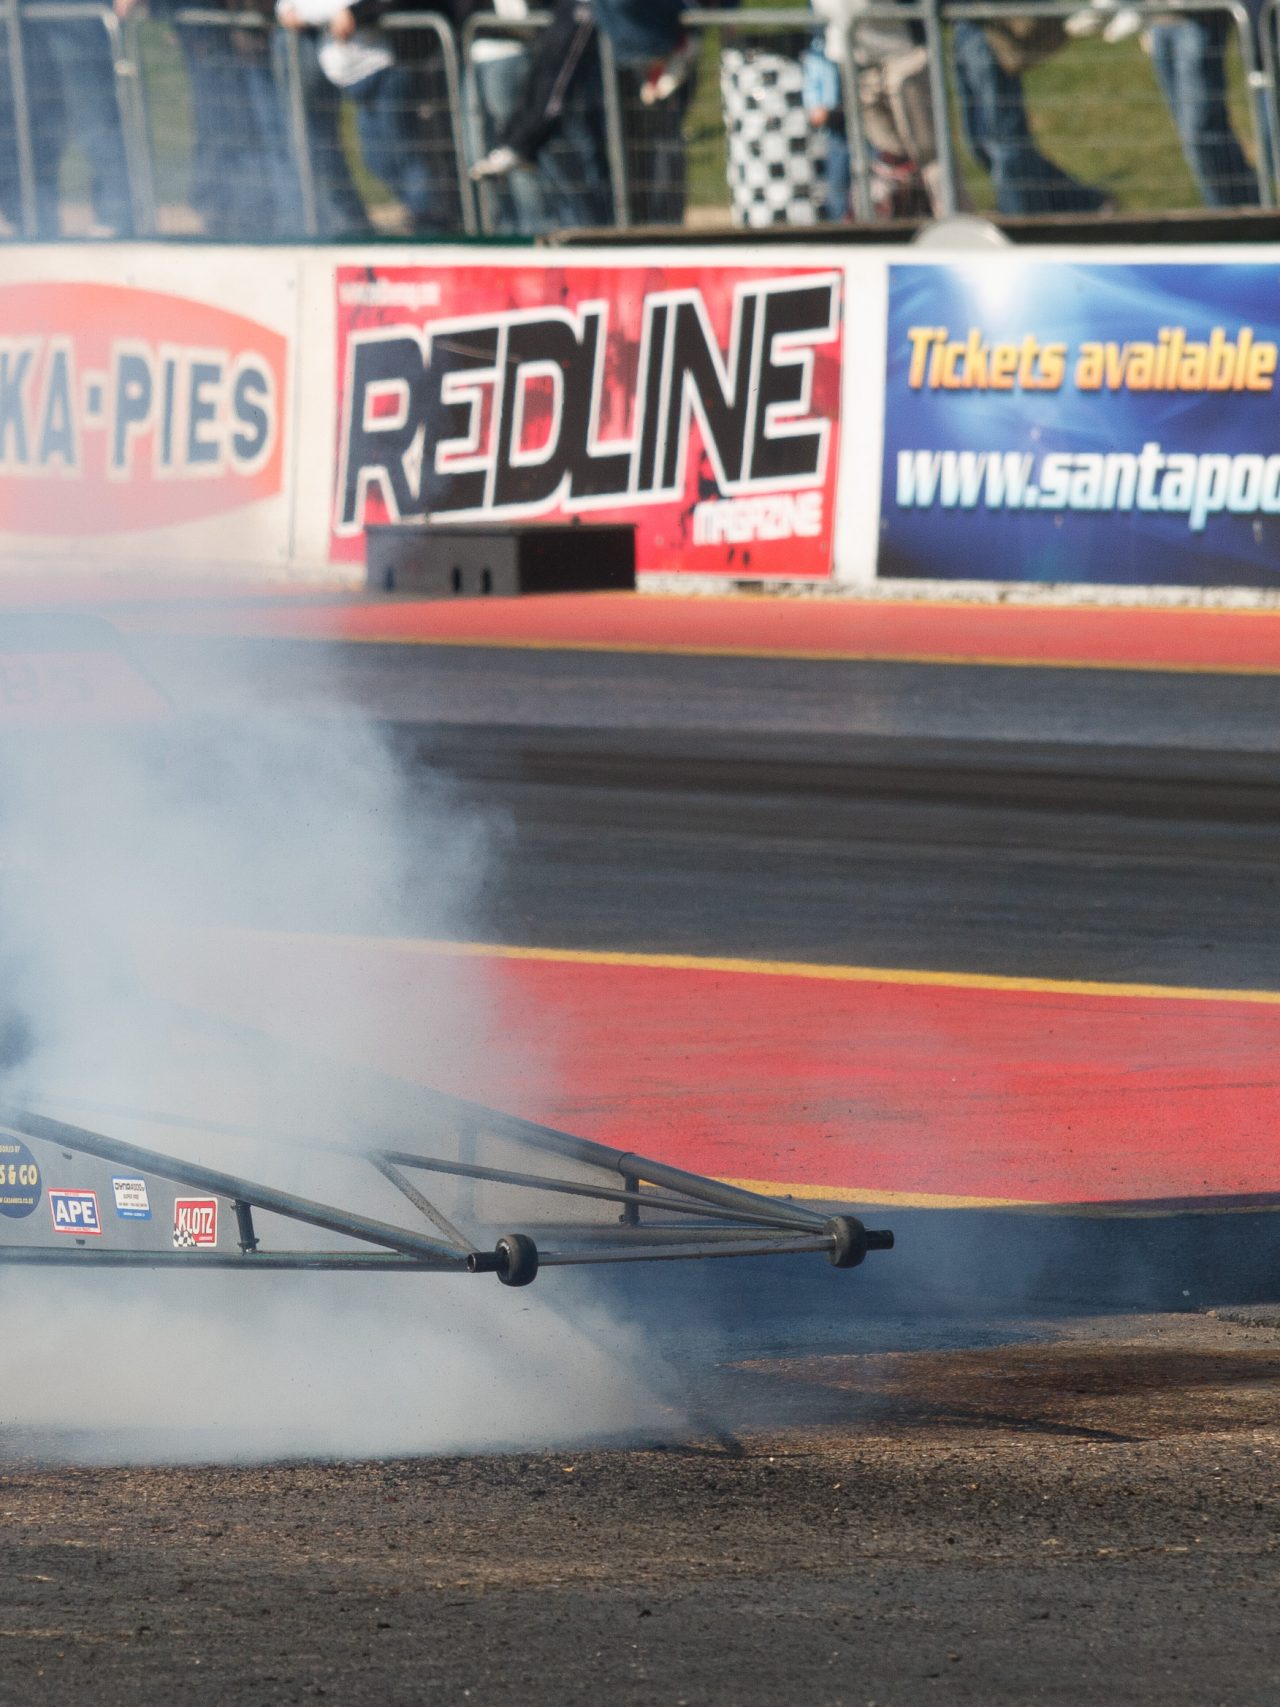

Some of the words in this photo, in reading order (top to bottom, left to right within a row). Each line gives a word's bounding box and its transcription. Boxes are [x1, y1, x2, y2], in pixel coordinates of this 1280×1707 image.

[906, 327, 1067, 390] Tickets
[1075, 327, 1277, 391] available
[334, 272, 841, 536] REDLINE
[8, 1165, 16, 1185] &
[19, 1165, 38, 1186] GO
[56, 1199, 96, 1224] APE
[178, 1207, 213, 1234] KLOTZ
